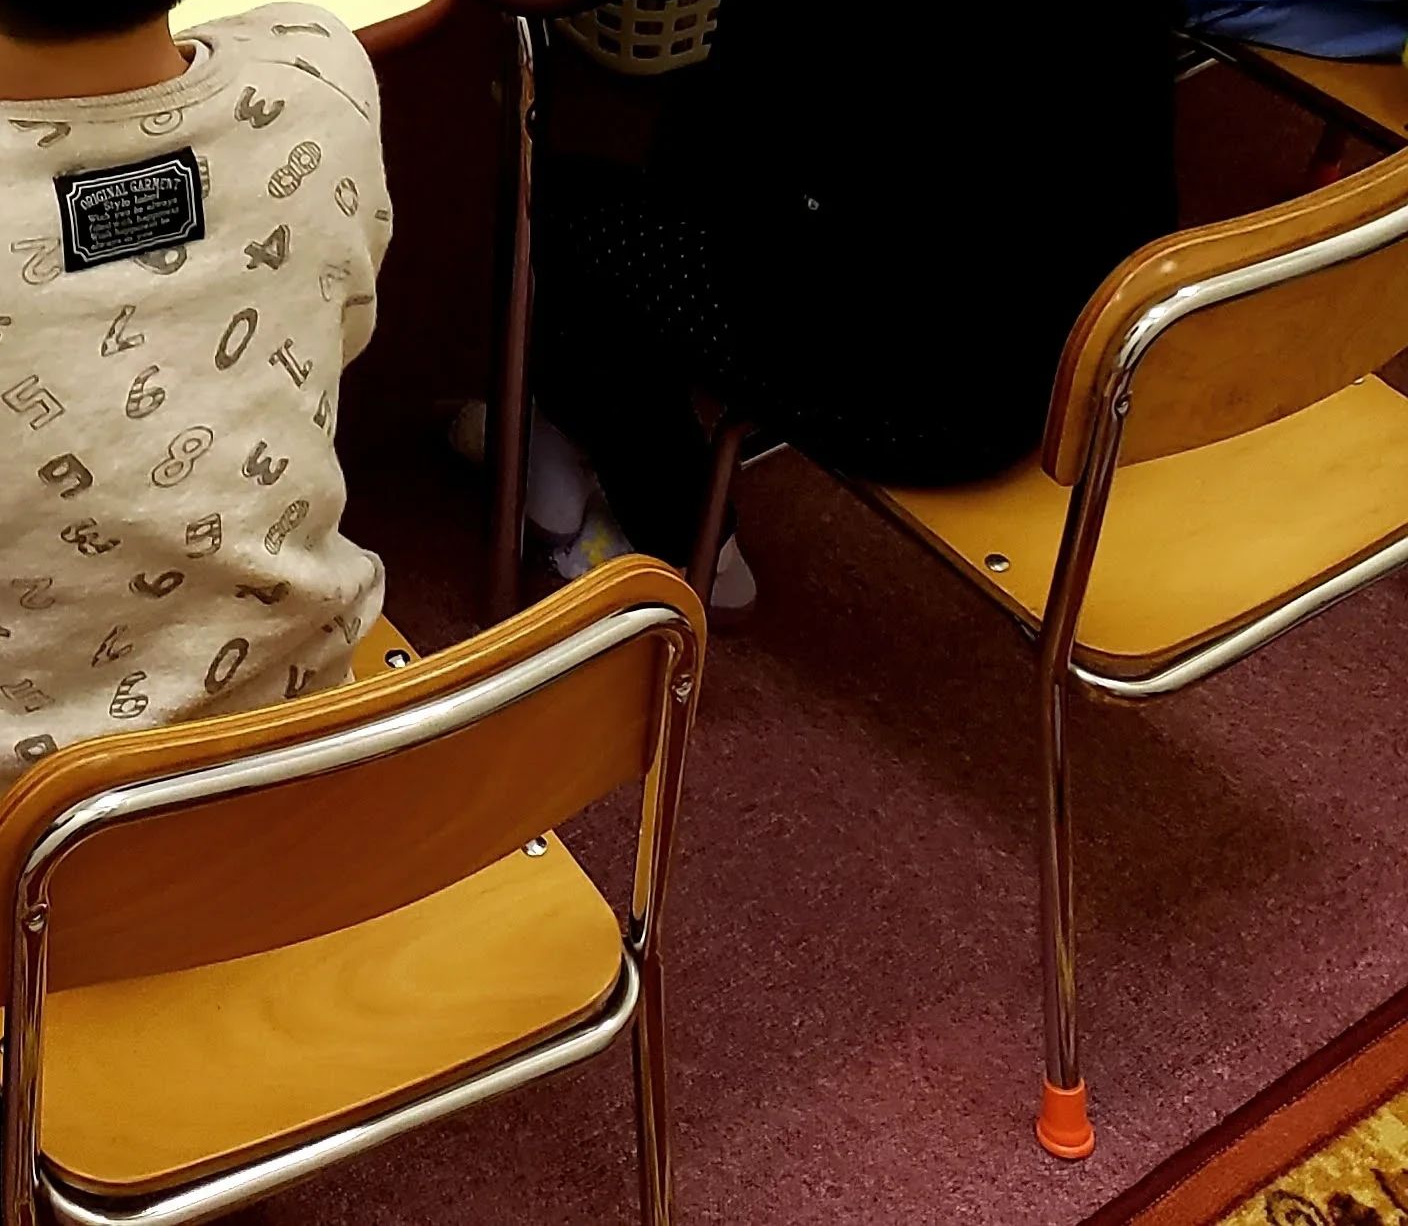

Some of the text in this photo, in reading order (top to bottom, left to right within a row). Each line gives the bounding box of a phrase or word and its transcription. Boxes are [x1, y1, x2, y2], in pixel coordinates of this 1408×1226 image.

[79, 177, 182, 211] ORIGINAL GARMENT
[267, 141, 322, 199] 8
[214, 306, 259, 371] 0
[150, 424, 214, 489] 8
[204, 636, 250, 695] 0
